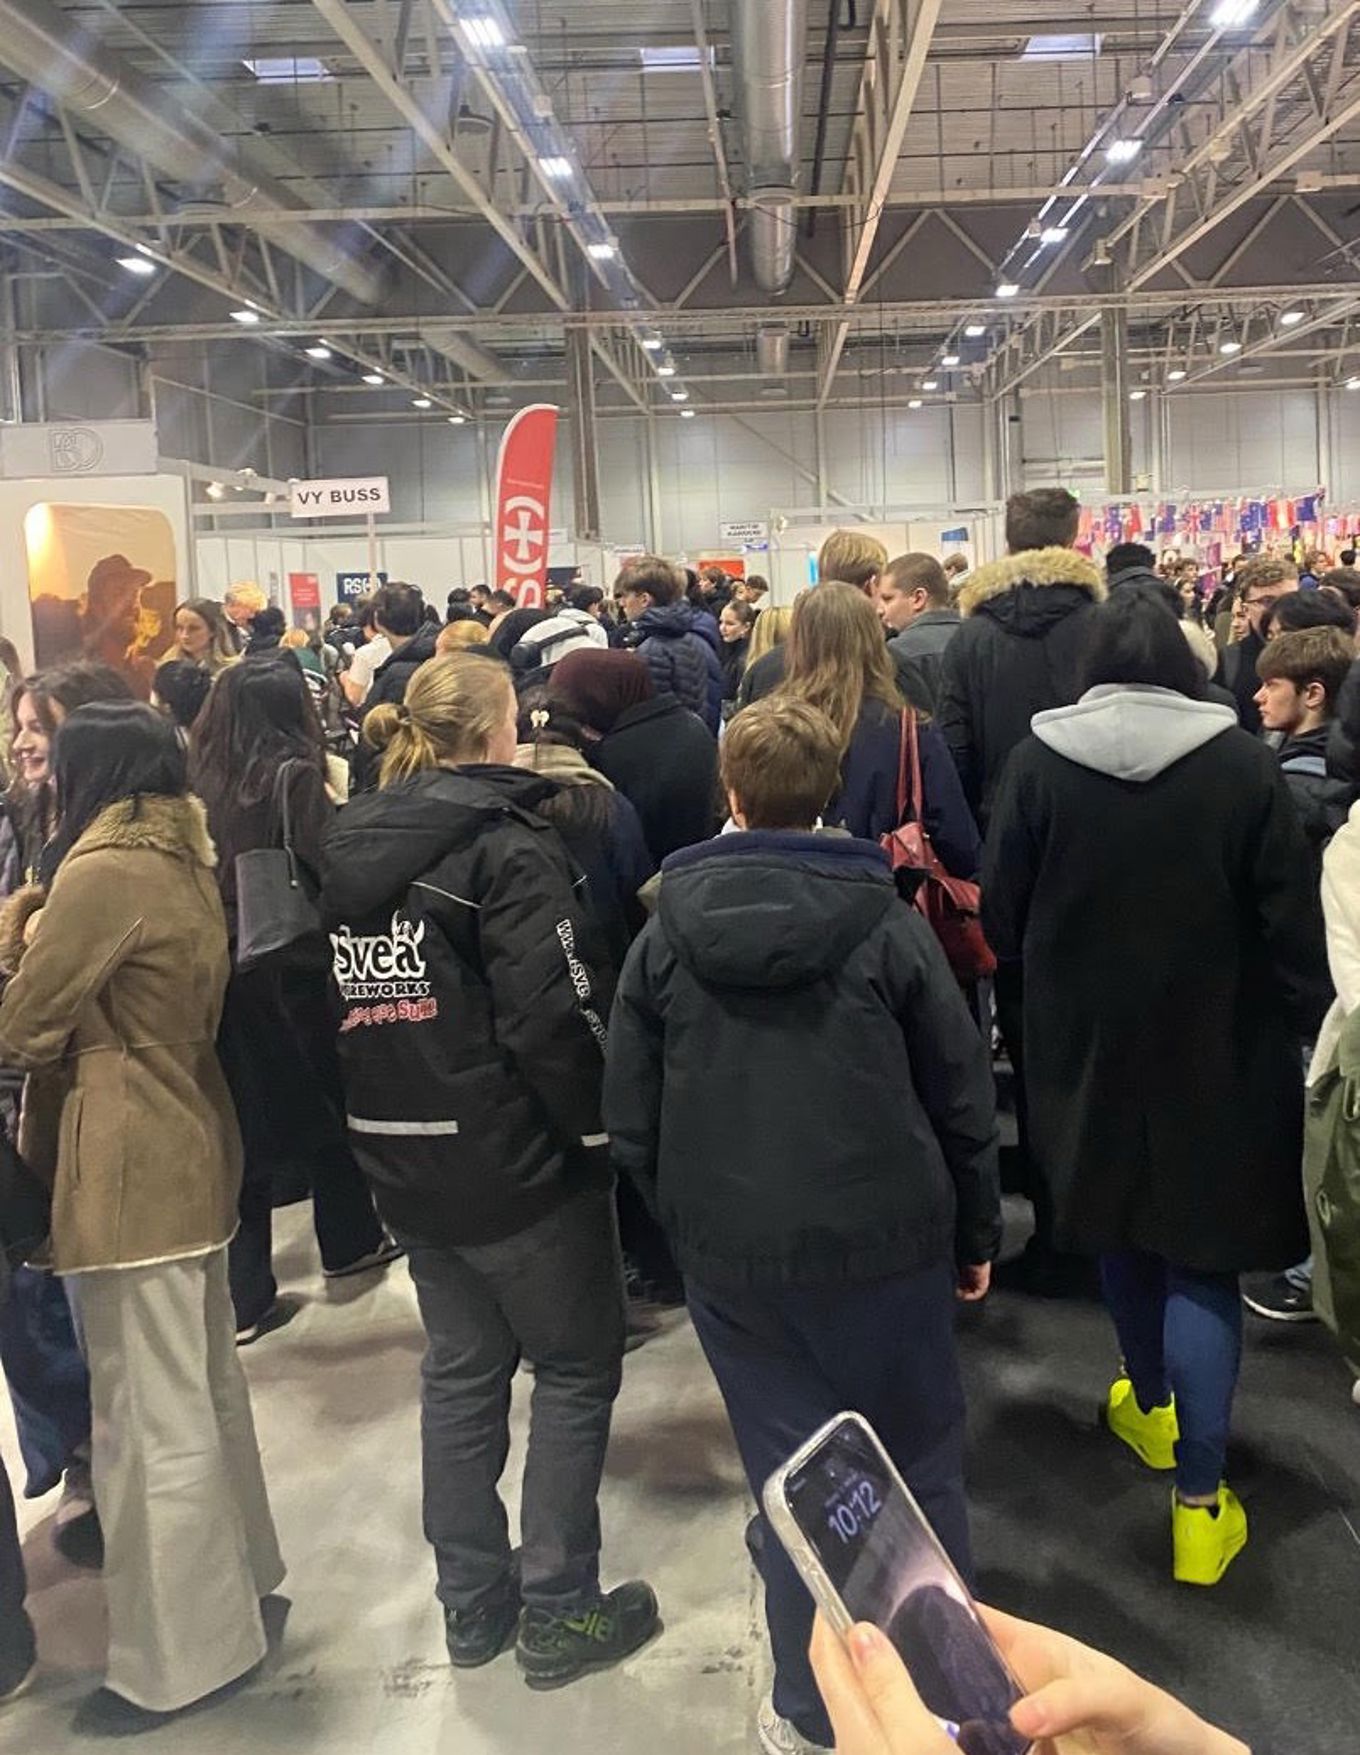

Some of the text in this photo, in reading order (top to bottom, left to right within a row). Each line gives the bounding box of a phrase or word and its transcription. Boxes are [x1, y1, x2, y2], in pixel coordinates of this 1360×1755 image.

[297, 487, 381, 504] VY BUSS
[339, 981, 431, 999] REWORKS
[828, 1480, 882, 1544] 10:12
